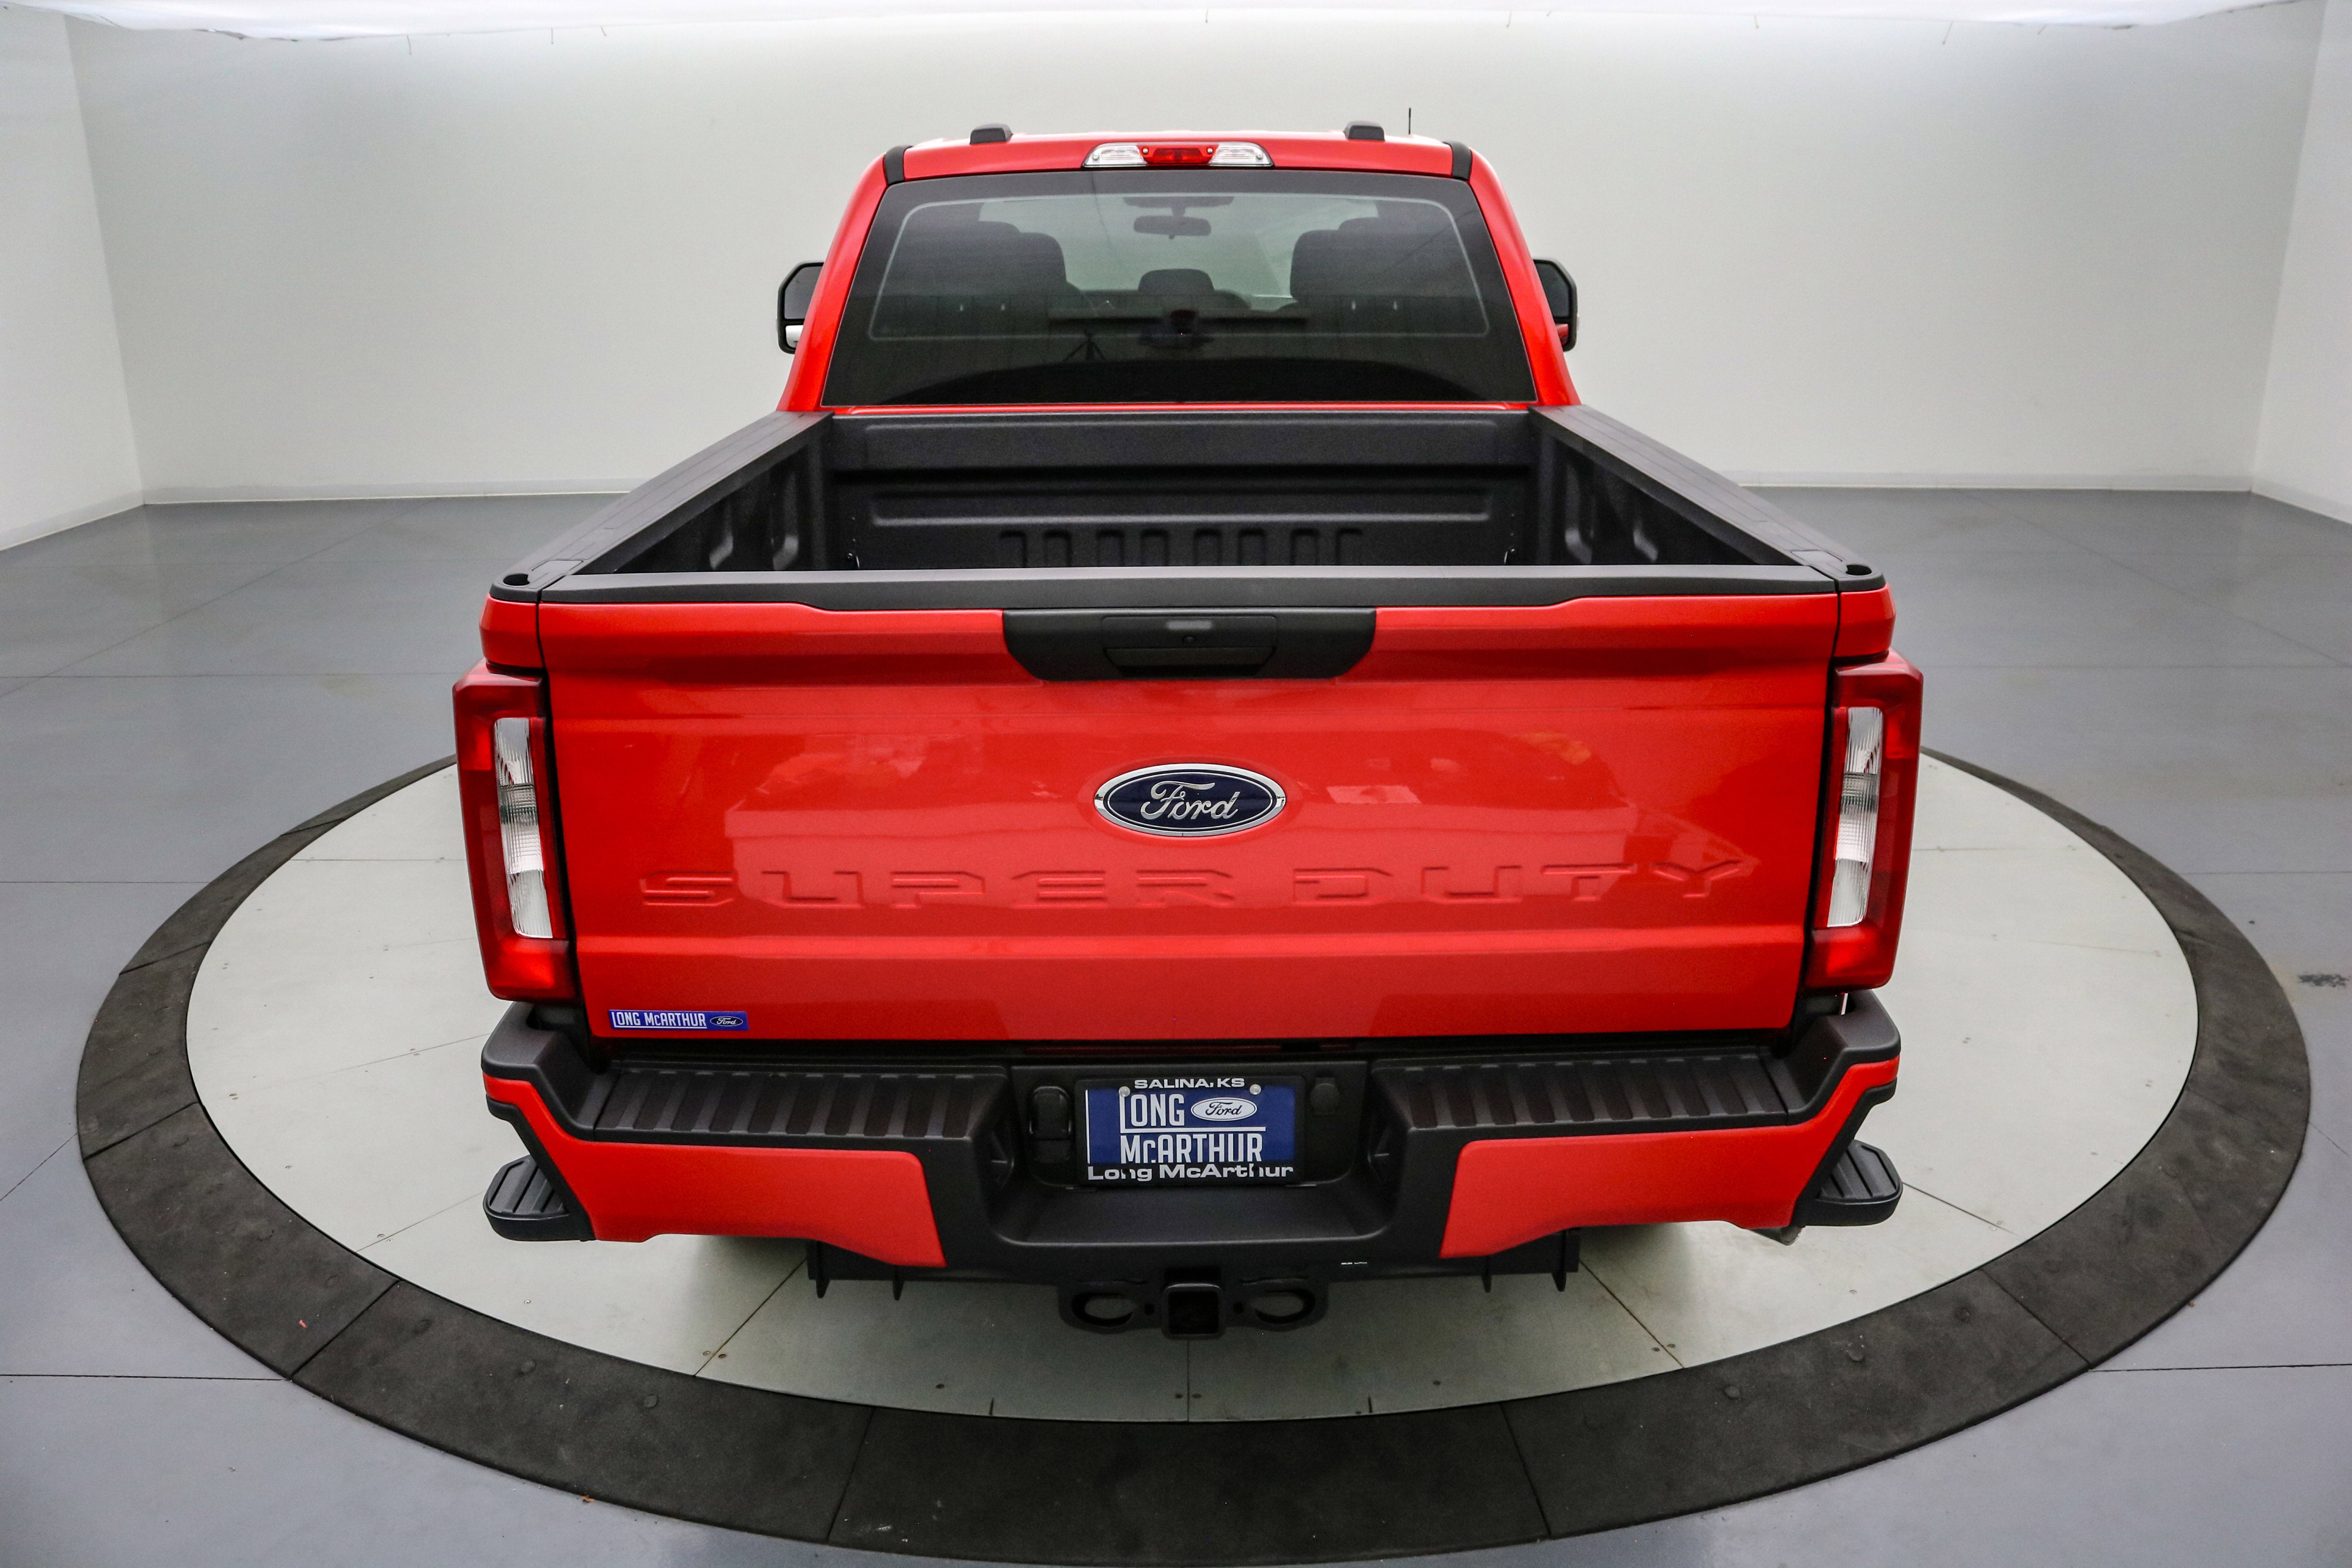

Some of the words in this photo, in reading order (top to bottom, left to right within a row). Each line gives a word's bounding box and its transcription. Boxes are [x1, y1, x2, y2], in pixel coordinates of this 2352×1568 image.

[1140, 781, 1240, 820] Ford
[639, 869, 1234, 909] SUPER
[1292, 860, 1742, 906] DUTY
[611, 1011, 641, 1028] LONG
[644, 1012, 707, 1027] McARTHUR
[1134, 1078, 1214, 1089] SALINA,
[1217, 1078, 1245, 1088] KS
[1119, 1094, 1185, 1134] LONG
[1205, 1102, 1242, 1116] Ford
[1120, 1133, 1263, 1164] McARTHUR
[1088, 1166, 1152, 1181] Long
[1159, 1163, 1294, 1178] McArthur
